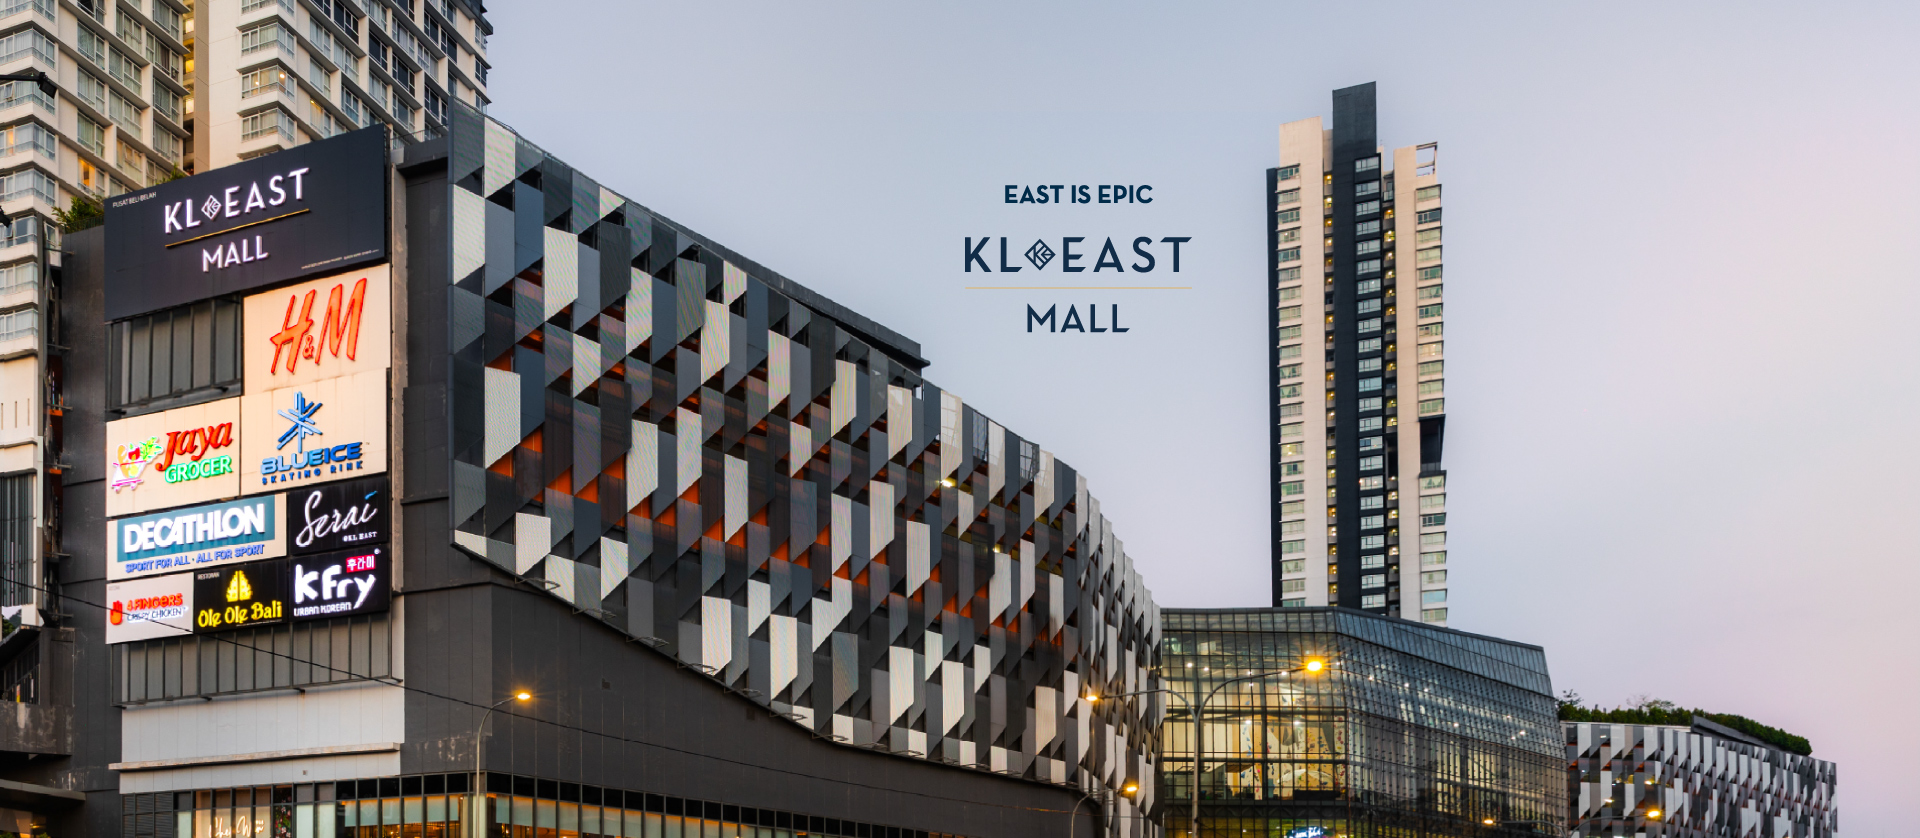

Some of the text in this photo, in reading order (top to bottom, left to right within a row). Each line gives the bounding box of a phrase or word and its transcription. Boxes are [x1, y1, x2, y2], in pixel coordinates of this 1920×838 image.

[164, 167, 310, 234] KL EAST
[202, 235, 269, 273] MALL
[269, 277, 367, 374] H&M
[155, 421, 233, 472] Jaya
[164, 455, 233, 484] GROCER
[261, 460, 363, 486] SKATING RINK
[123, 503, 266, 554] DECATHLON
[295, 489, 379, 548] Serai
[125, 544, 265, 574] SPORT FOR ALL ALL FOR SPORT
[151, 607, 182, 619] CHICKEN
[198, 608, 222, 628] Ole
[224, 605, 249, 624] Ole
[250, 599, 283, 620] Bali
[293, 602, 352, 617] URBAN KOREAN
